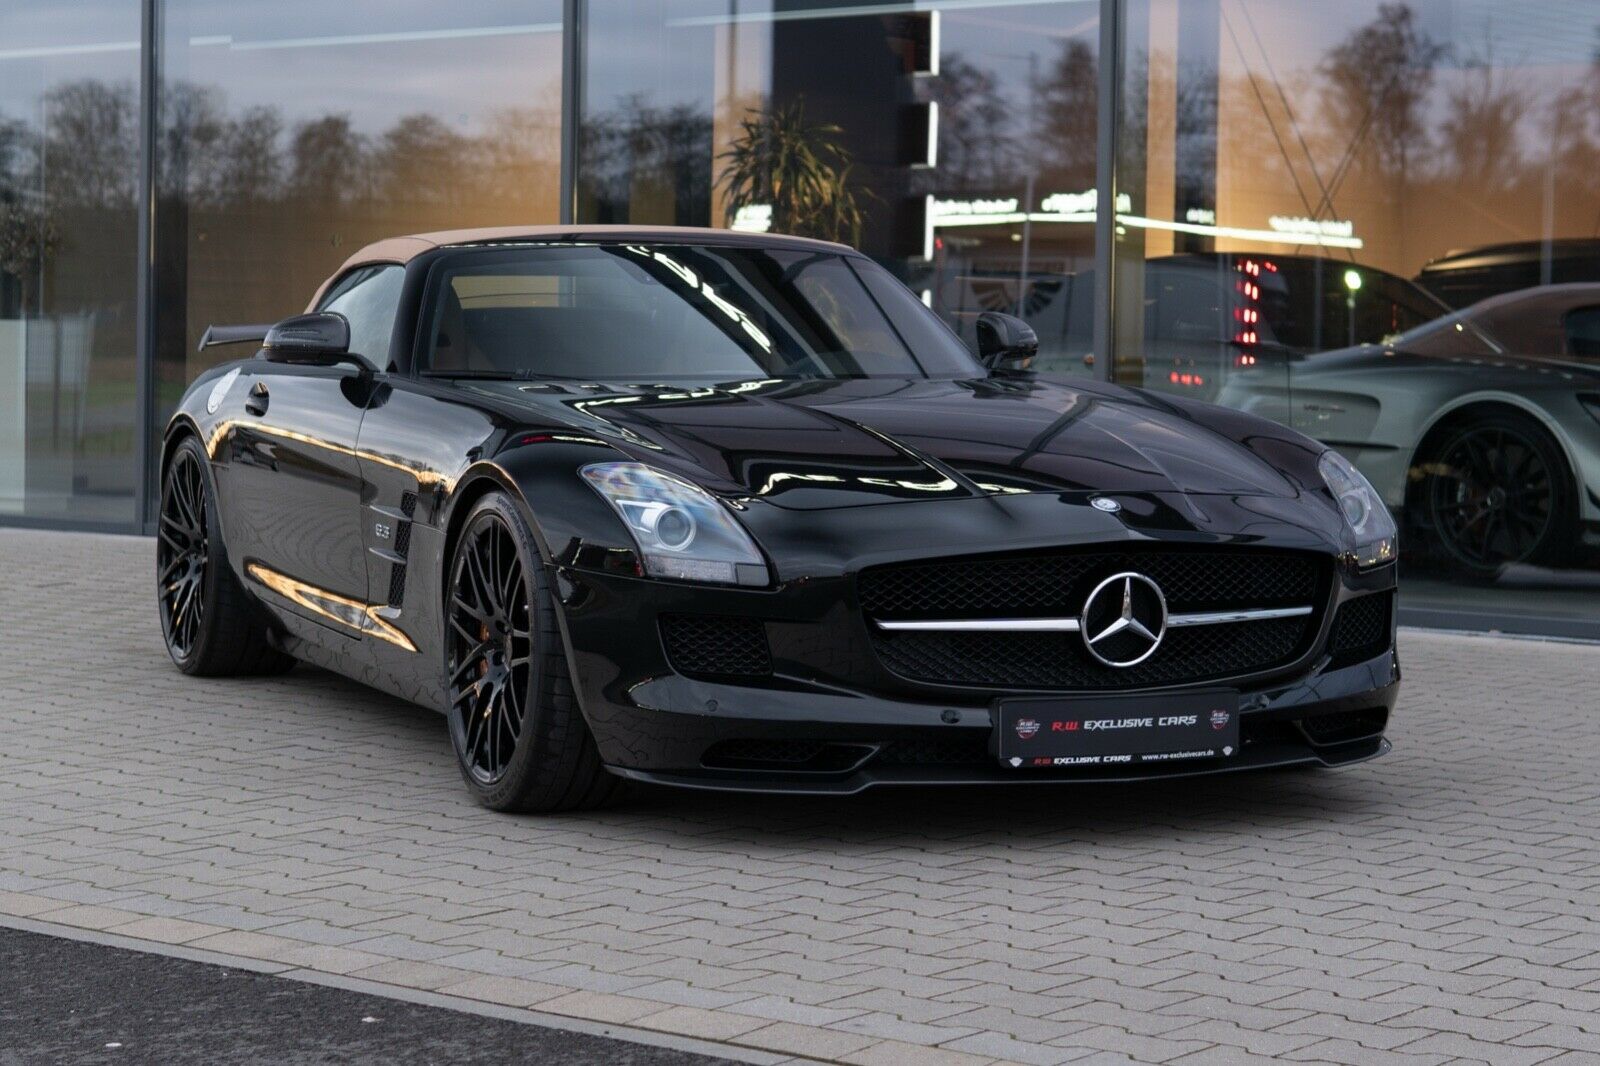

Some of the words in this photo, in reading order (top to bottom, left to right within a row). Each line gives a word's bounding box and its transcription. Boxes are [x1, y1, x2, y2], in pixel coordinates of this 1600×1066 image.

[1083, 718, 1153, 731] EXCLUSIVE
[1158, 715, 1198, 727] CARS
[1054, 756, 1101, 764] EXCLUSIVE
[1142, 749, 1214, 760] www.rw-exclusivecars.de
